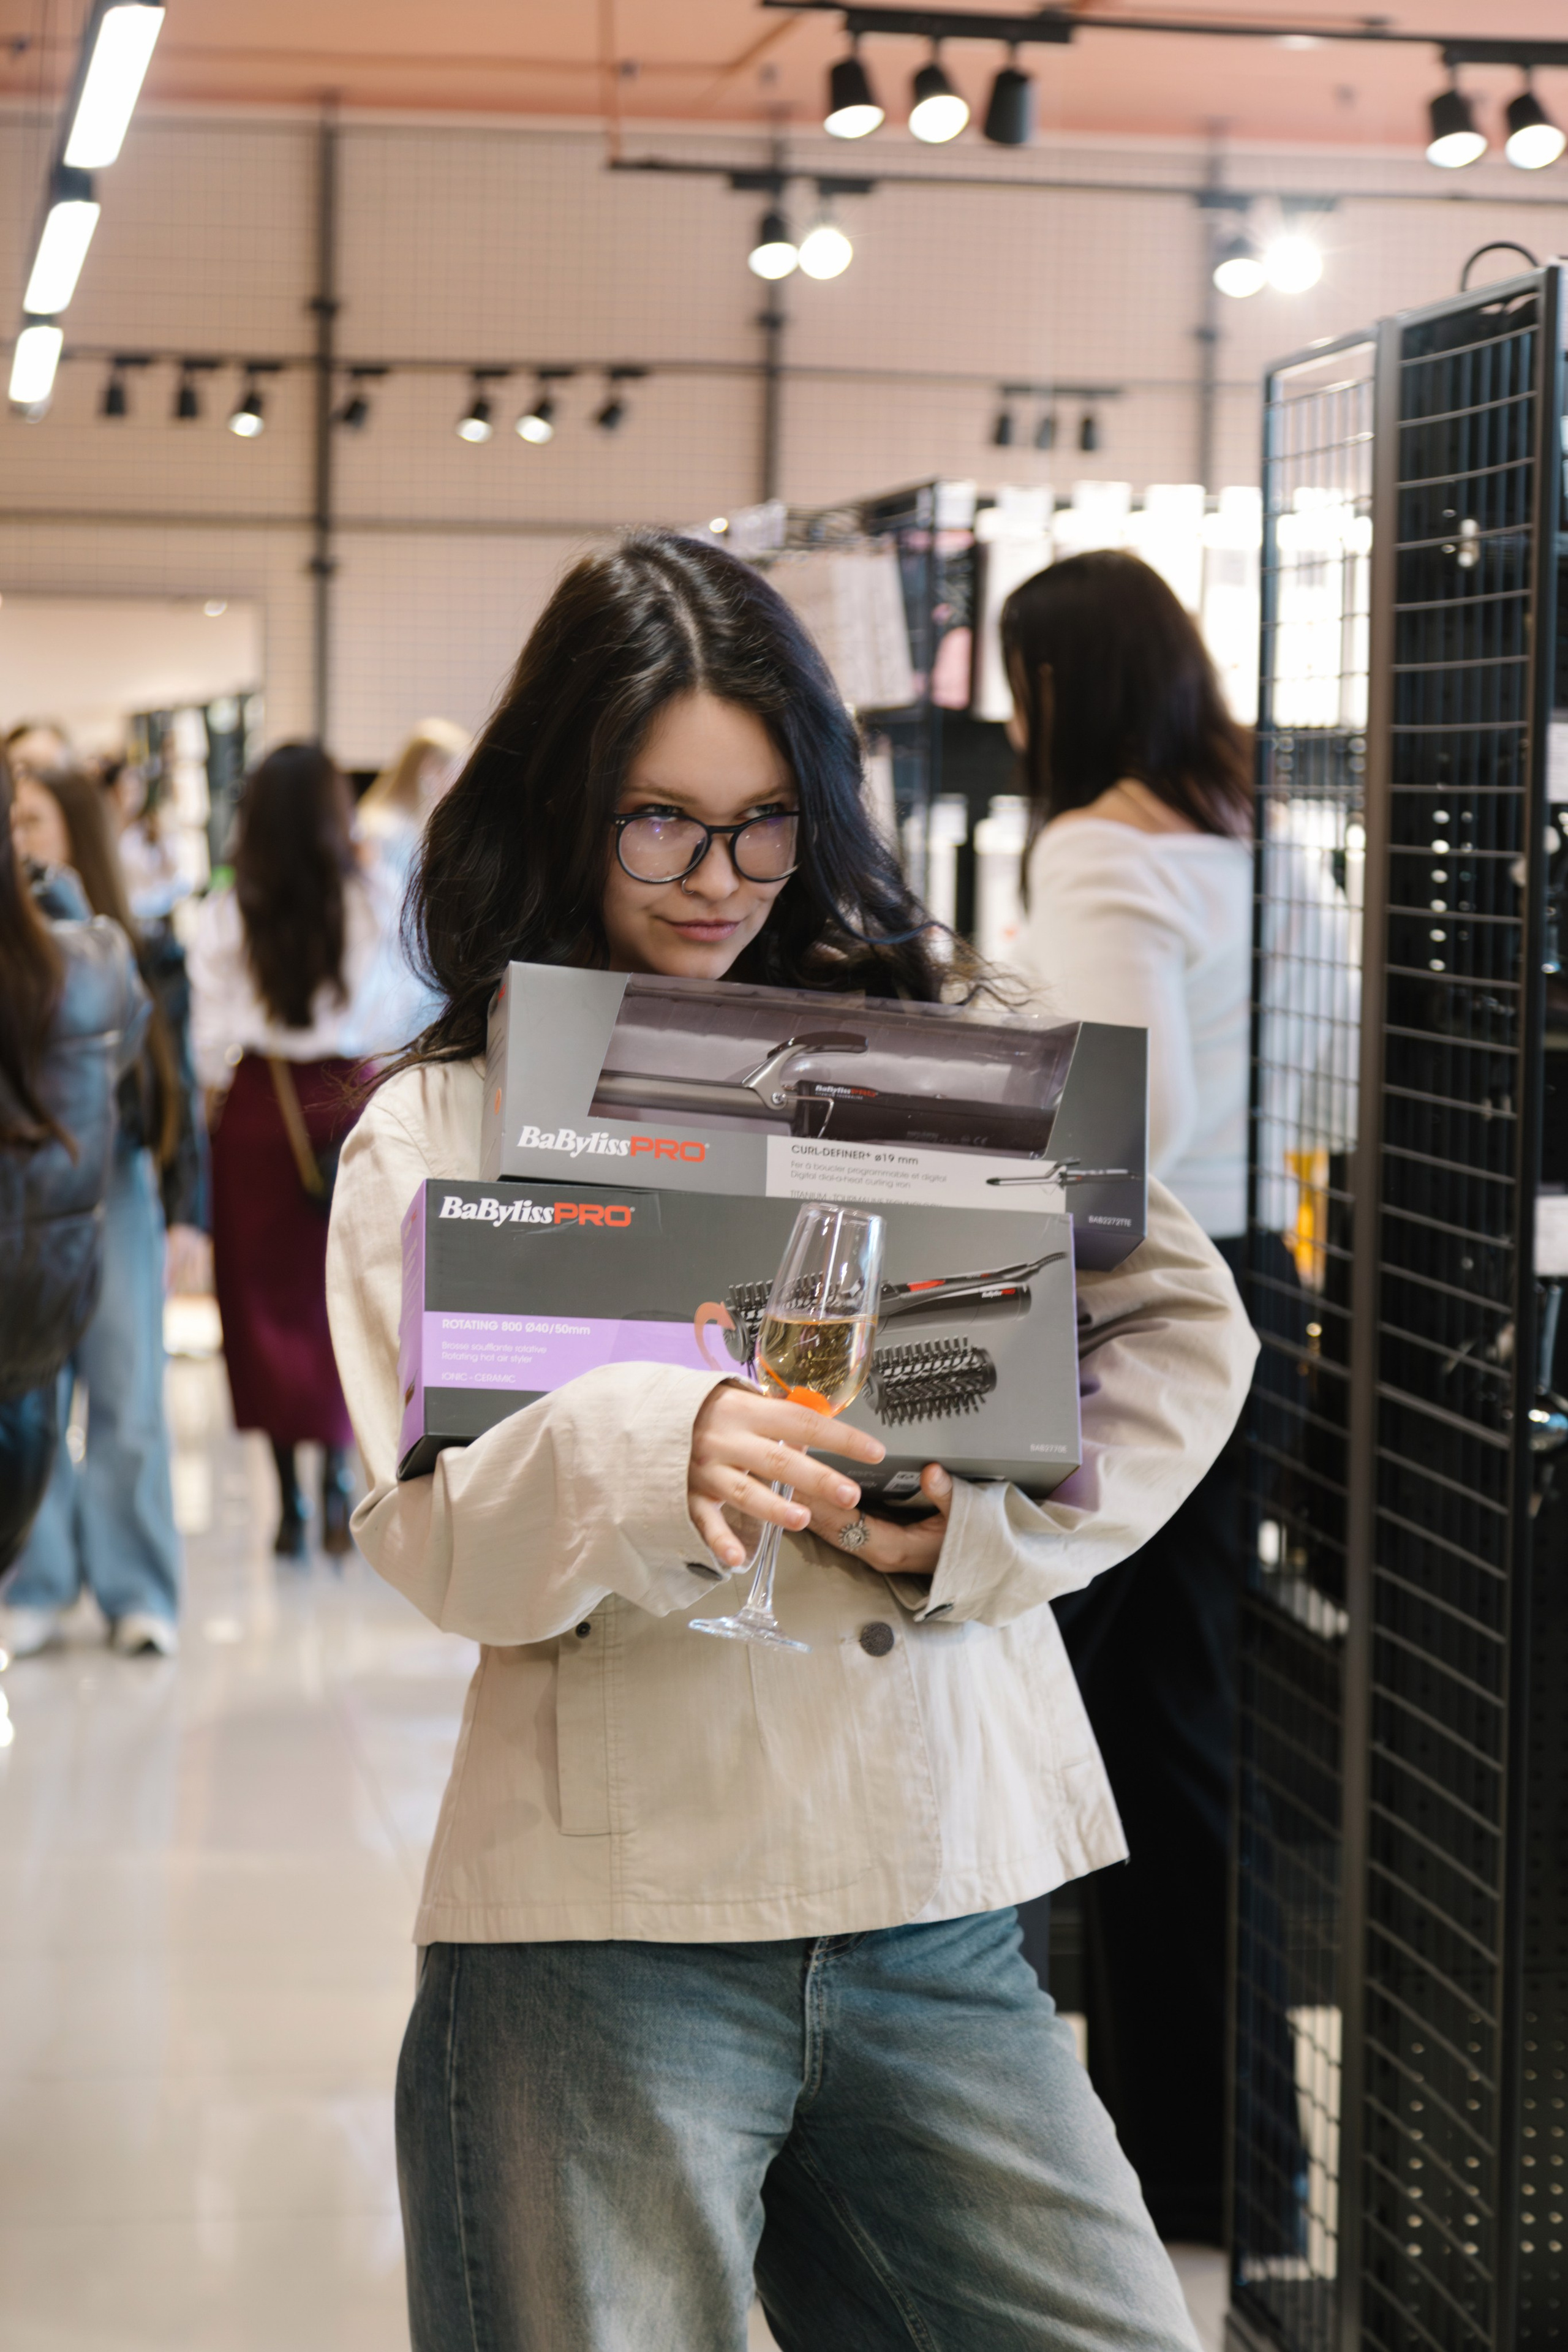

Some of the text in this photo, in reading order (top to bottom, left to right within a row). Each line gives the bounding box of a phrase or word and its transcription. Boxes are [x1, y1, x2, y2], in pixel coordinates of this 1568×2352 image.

[898, 1156, 918, 1165] mm
[791, 1160, 803, 1169] Fer
[813, 1163, 845, 1172] boucler
[847, 1166, 909, 1178] programmable
[921, 1173, 947, 1183] digital
[791, 1170, 816, 1180] Digital
[865, 1178, 893, 1189] curling
[442, 1319, 499, 1331] ROTATING
[501, 1321, 522, 1332] 800
[442, 1341, 547, 1354] Brosse soufflante rotative
[442, 1351, 533, 1364] Rotating hot air styler
[442, 1372, 467, 1381] IONIC
[474, 1373, 516, 1383] CERAMIC
